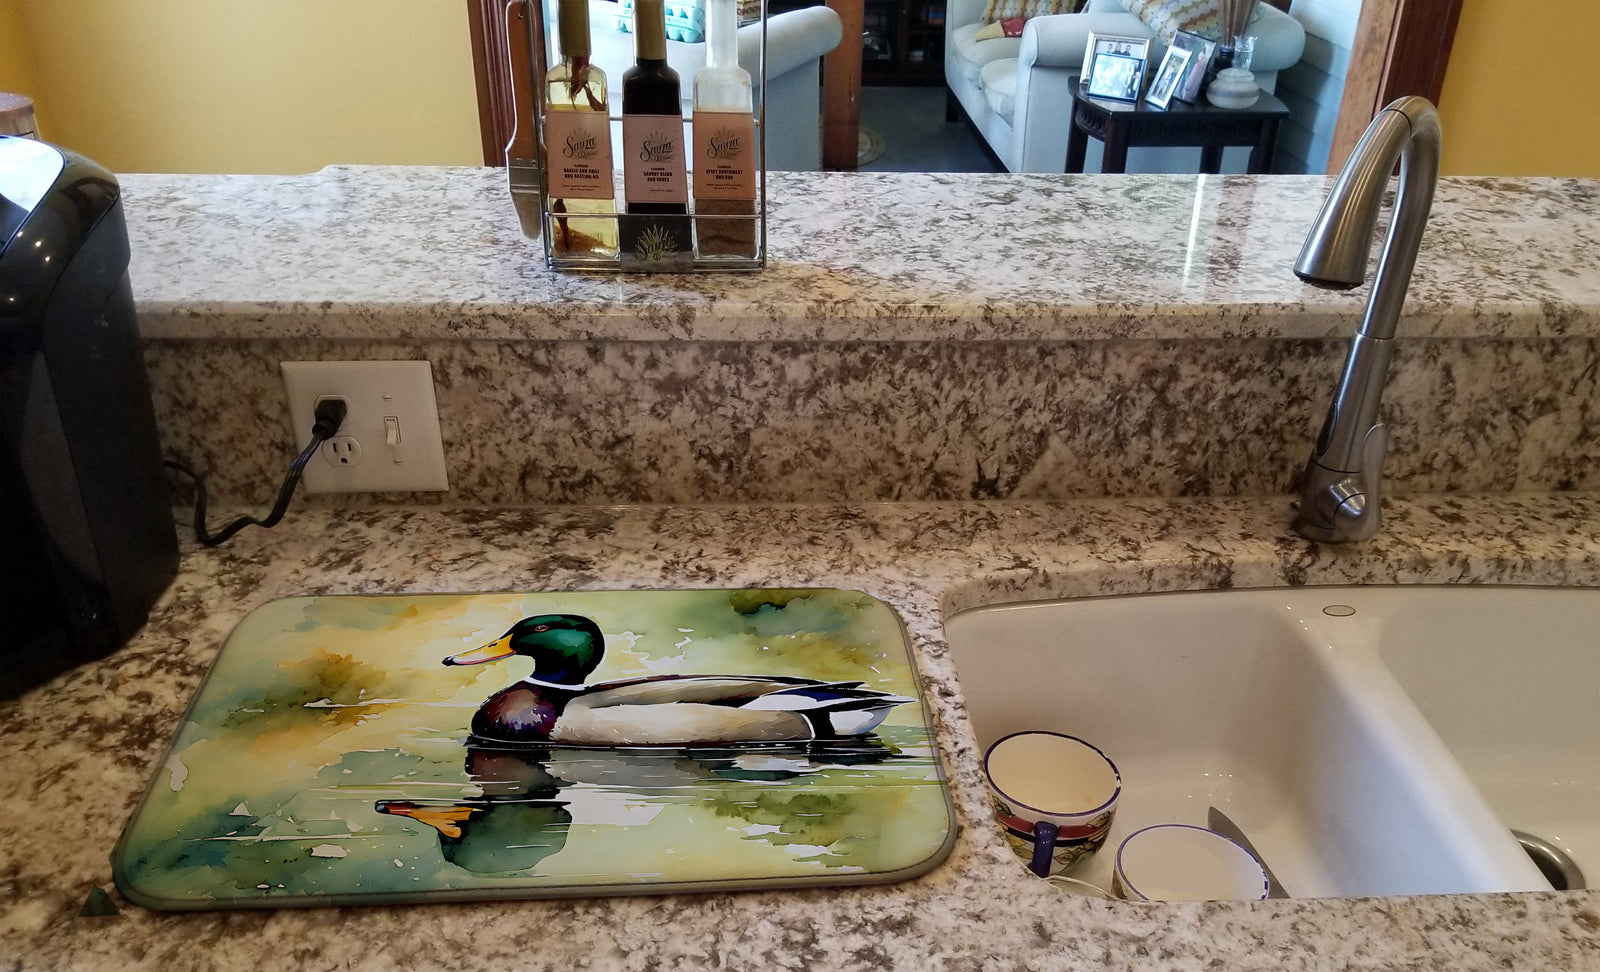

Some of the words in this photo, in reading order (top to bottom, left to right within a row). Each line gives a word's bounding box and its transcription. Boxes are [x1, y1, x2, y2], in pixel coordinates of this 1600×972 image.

[563, 135, 598, 159] Sauza
[639, 139, 674, 162] Sauza
[706, 136, 740, 159] Sauza
